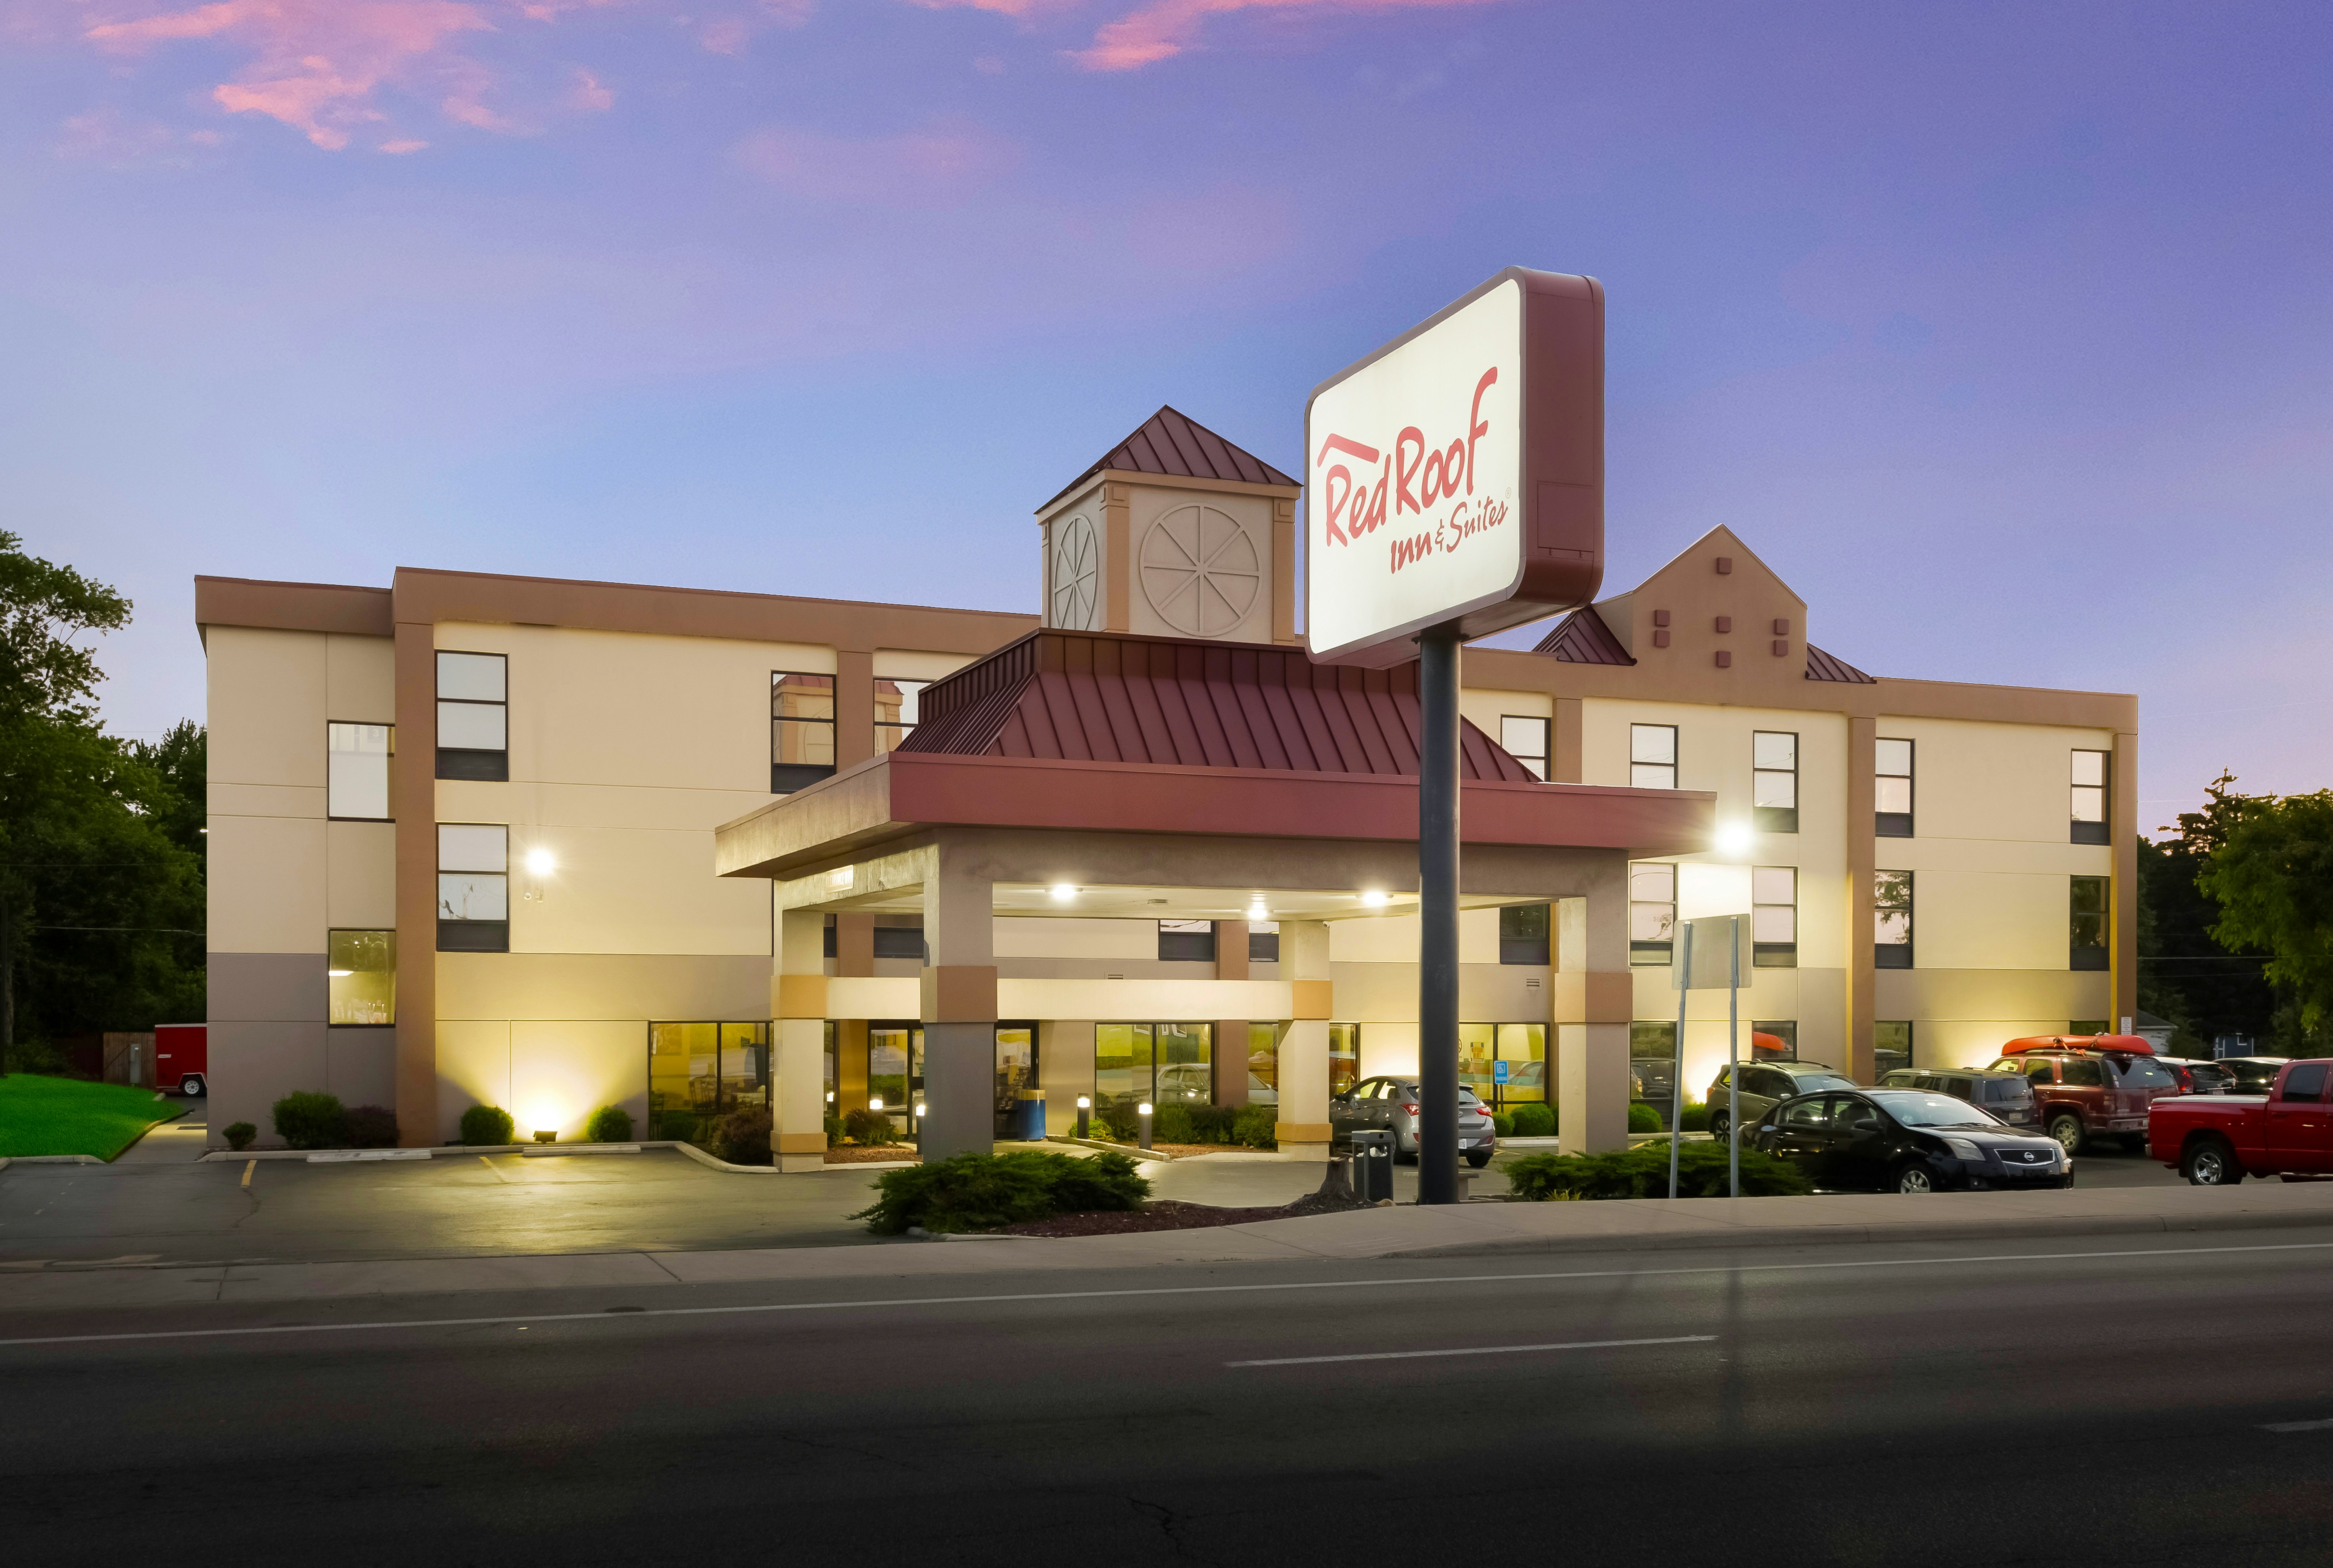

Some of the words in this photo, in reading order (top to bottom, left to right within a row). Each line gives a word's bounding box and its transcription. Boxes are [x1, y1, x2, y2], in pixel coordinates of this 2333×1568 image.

[1326, 454, 1391, 547] Red
[1396, 367, 1498, 515] Roof
[1435, 518, 1445, 552] &
[1447, 496, 1508, 553] Suites
